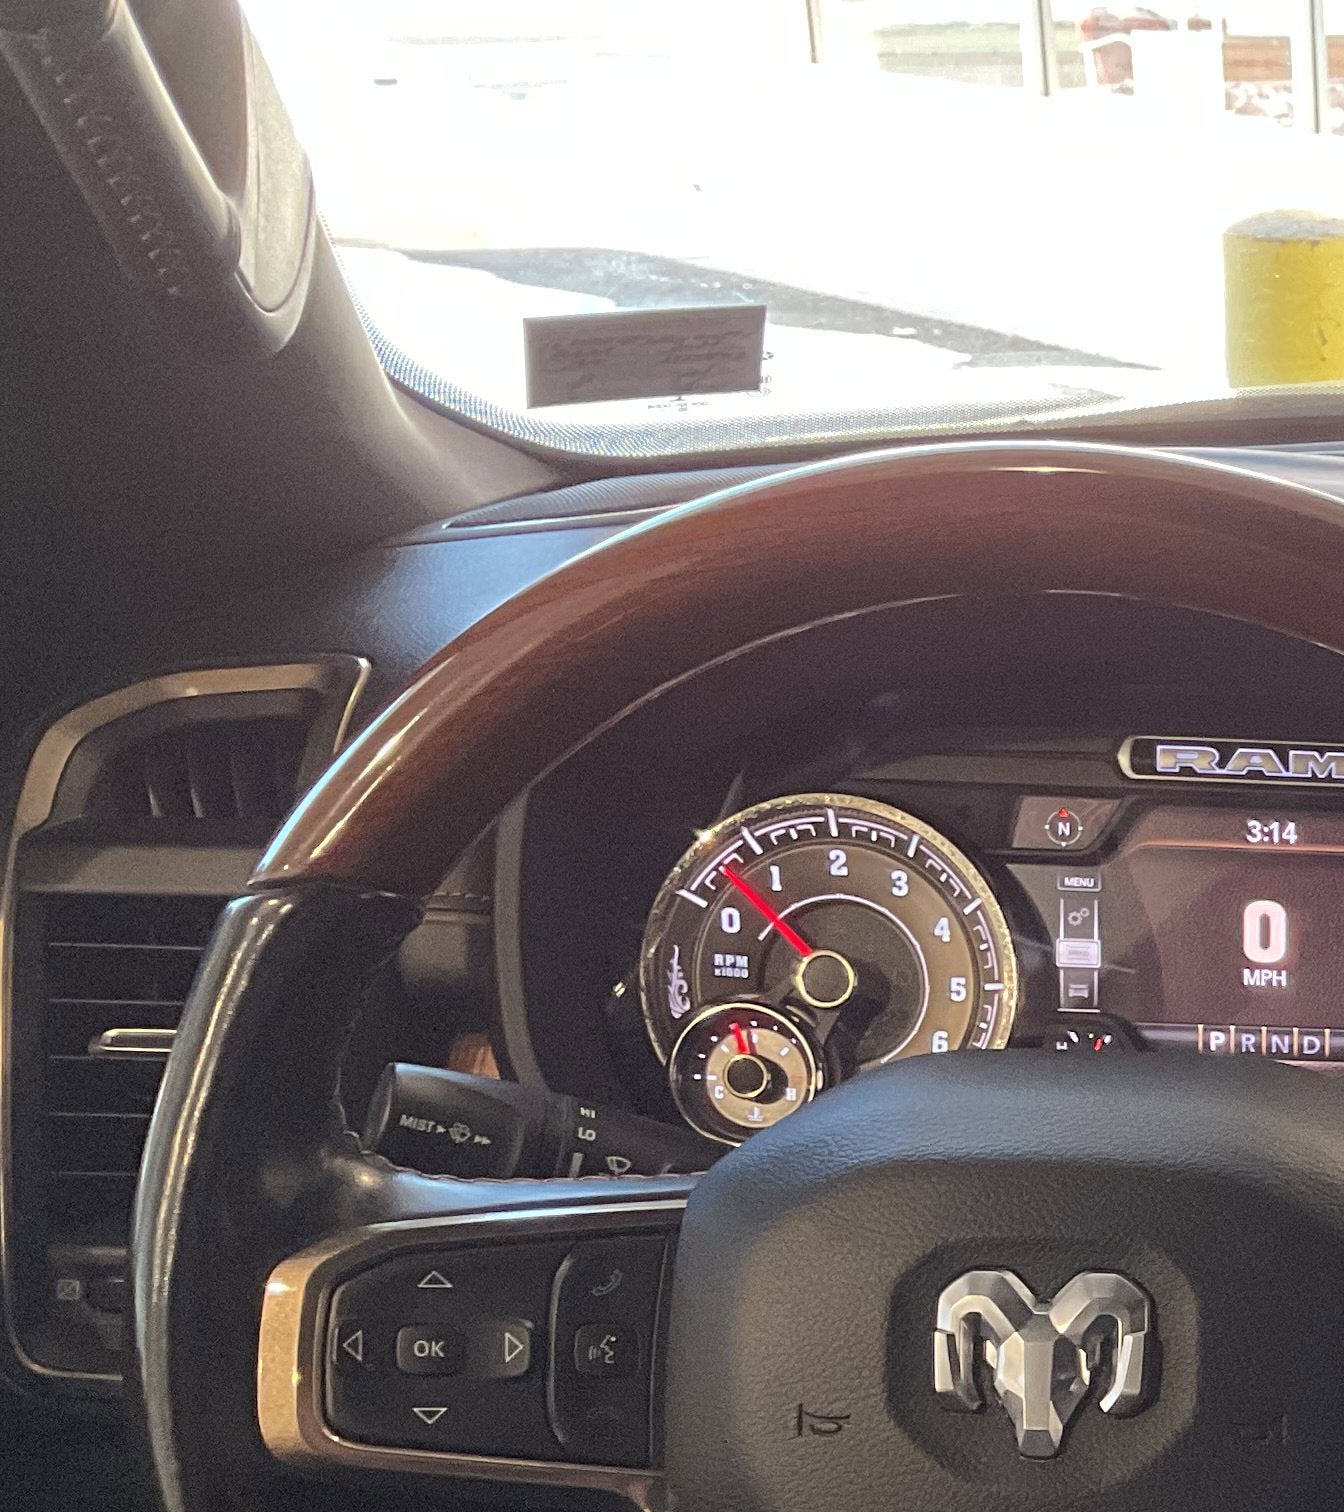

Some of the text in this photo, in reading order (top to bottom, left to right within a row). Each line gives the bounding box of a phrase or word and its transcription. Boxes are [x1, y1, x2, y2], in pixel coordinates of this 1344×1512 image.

[1058, 822, 1071, 836] N
[1246, 820, 1298, 845] 3:14
[828, 850, 848, 876] 2
[770, 865, 783, 892] 1
[891, 870, 909, 896] 3
[1064, 877, 1095, 887] MENU
[721, 907, 741, 933] 0
[933, 917, 951, 942] 4
[1243, 900, 1287, 963] 0
[713, 954, 749, 968] RPM
[1243, 969, 1287, 987] MPH
[950, 977, 967, 1002] 5
[931, 1030, 949, 1052] 6
[1210, 1031, 1321, 1054] P R N D
[714, 1087, 725, 1099] C
[580, 1106, 596, 1118] HI
[400, 1114, 434, 1133] MIST
[577, 1127, 597, 1141] LO
[413, 1339, 445, 1358] OK
